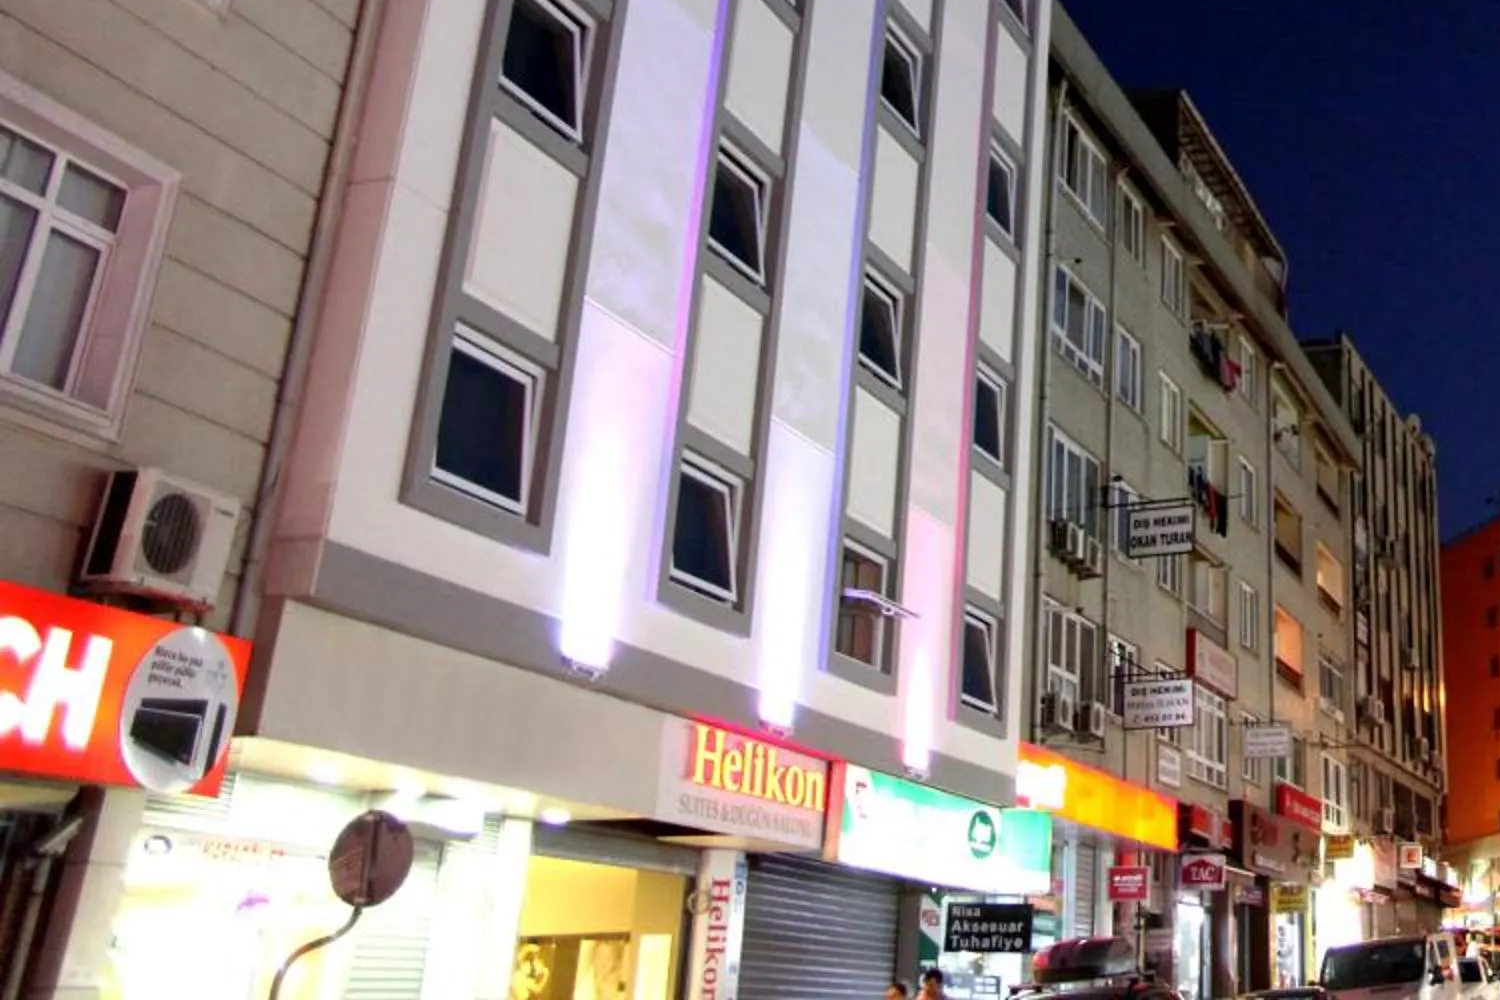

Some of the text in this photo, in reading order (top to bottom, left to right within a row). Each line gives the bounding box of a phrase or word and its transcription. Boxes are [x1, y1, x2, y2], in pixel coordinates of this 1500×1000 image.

[692, 724, 824, 812] Helikon
[951, 920, 1025, 933] Aksesuar
[949, 934, 1024, 951] Tuhafiye
